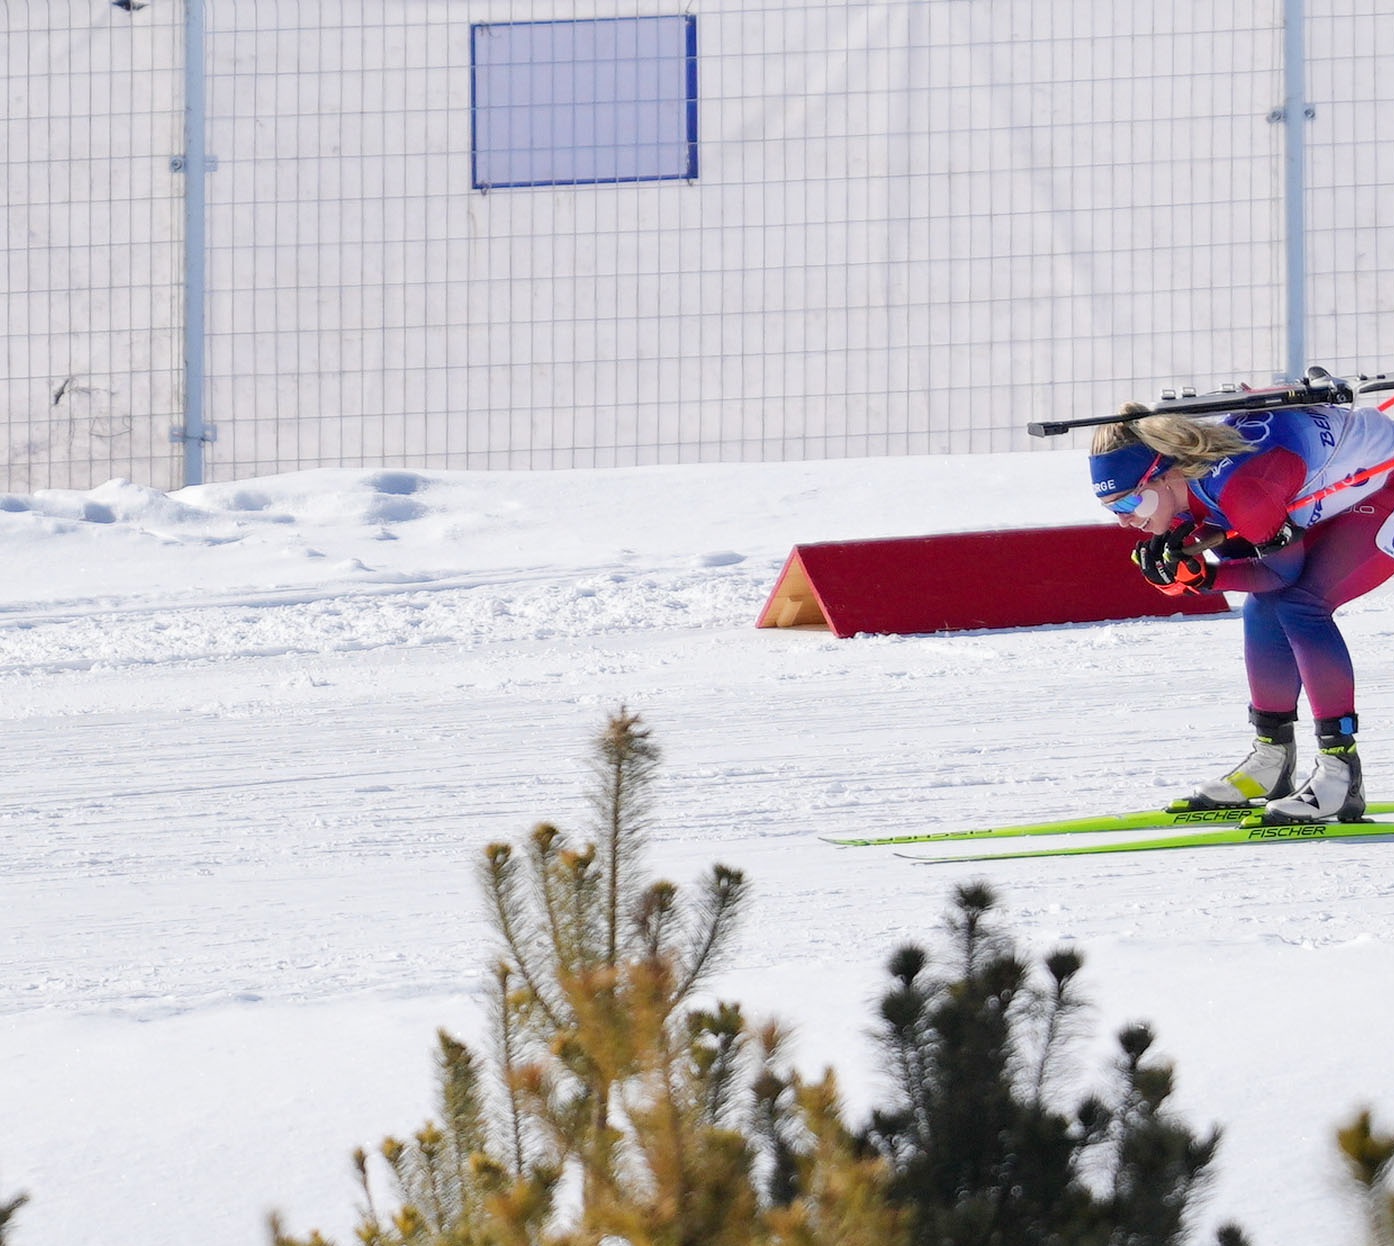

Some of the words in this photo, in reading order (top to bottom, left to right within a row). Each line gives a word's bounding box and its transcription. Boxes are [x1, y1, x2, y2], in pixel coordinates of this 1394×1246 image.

[1093, 479, 1116, 493] RGE
[1173, 810, 1253, 823] FISCHER
[1248, 825, 1327, 839] FISCHER
